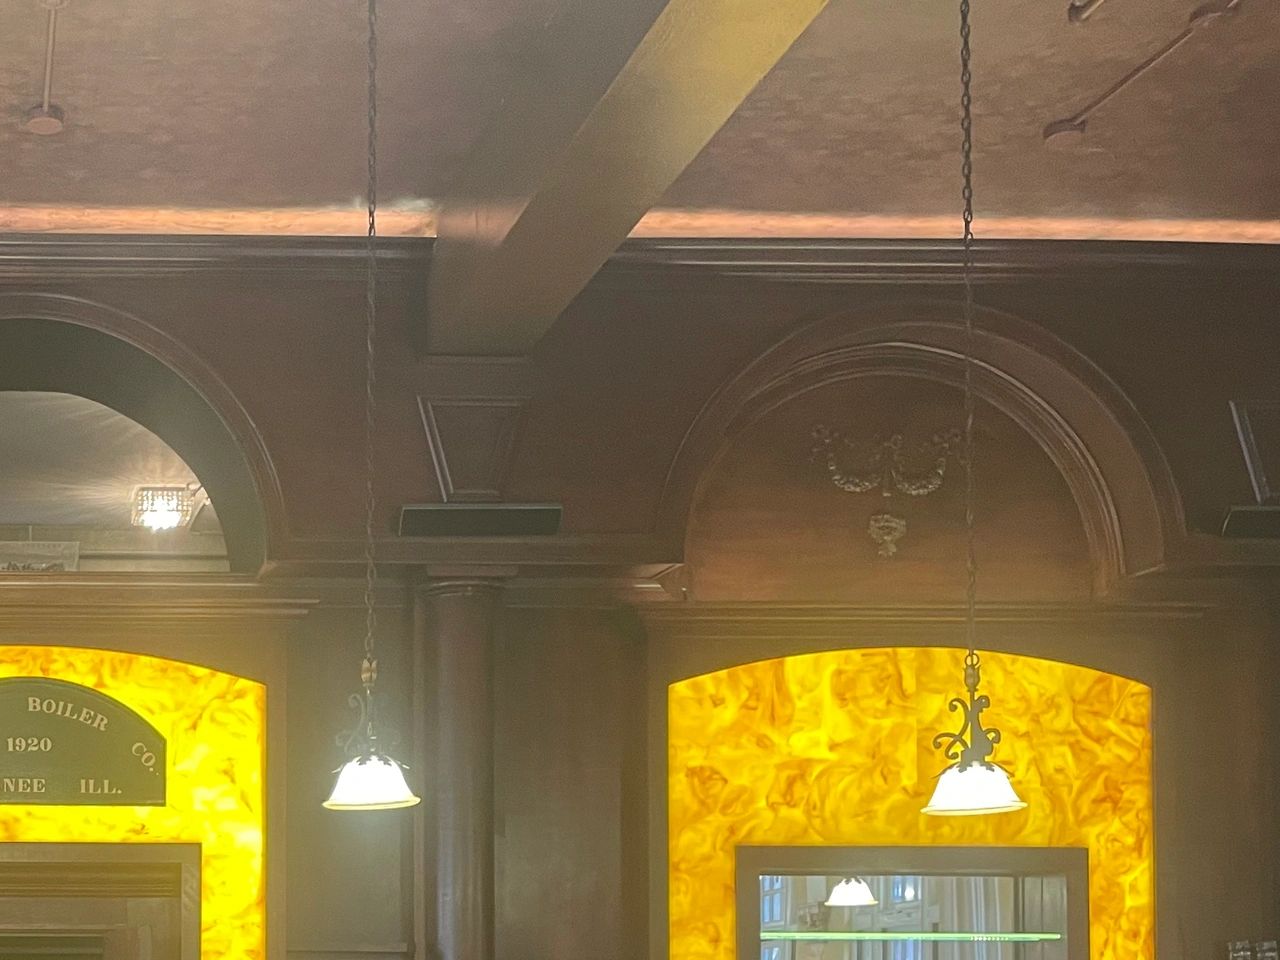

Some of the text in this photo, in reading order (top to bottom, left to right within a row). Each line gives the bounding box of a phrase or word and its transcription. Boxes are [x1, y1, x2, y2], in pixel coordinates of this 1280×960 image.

[27, 696, 109, 731] BOILER
[6, 737, 52, 752] 1920
[79, 779, 123, 794] ILL.
